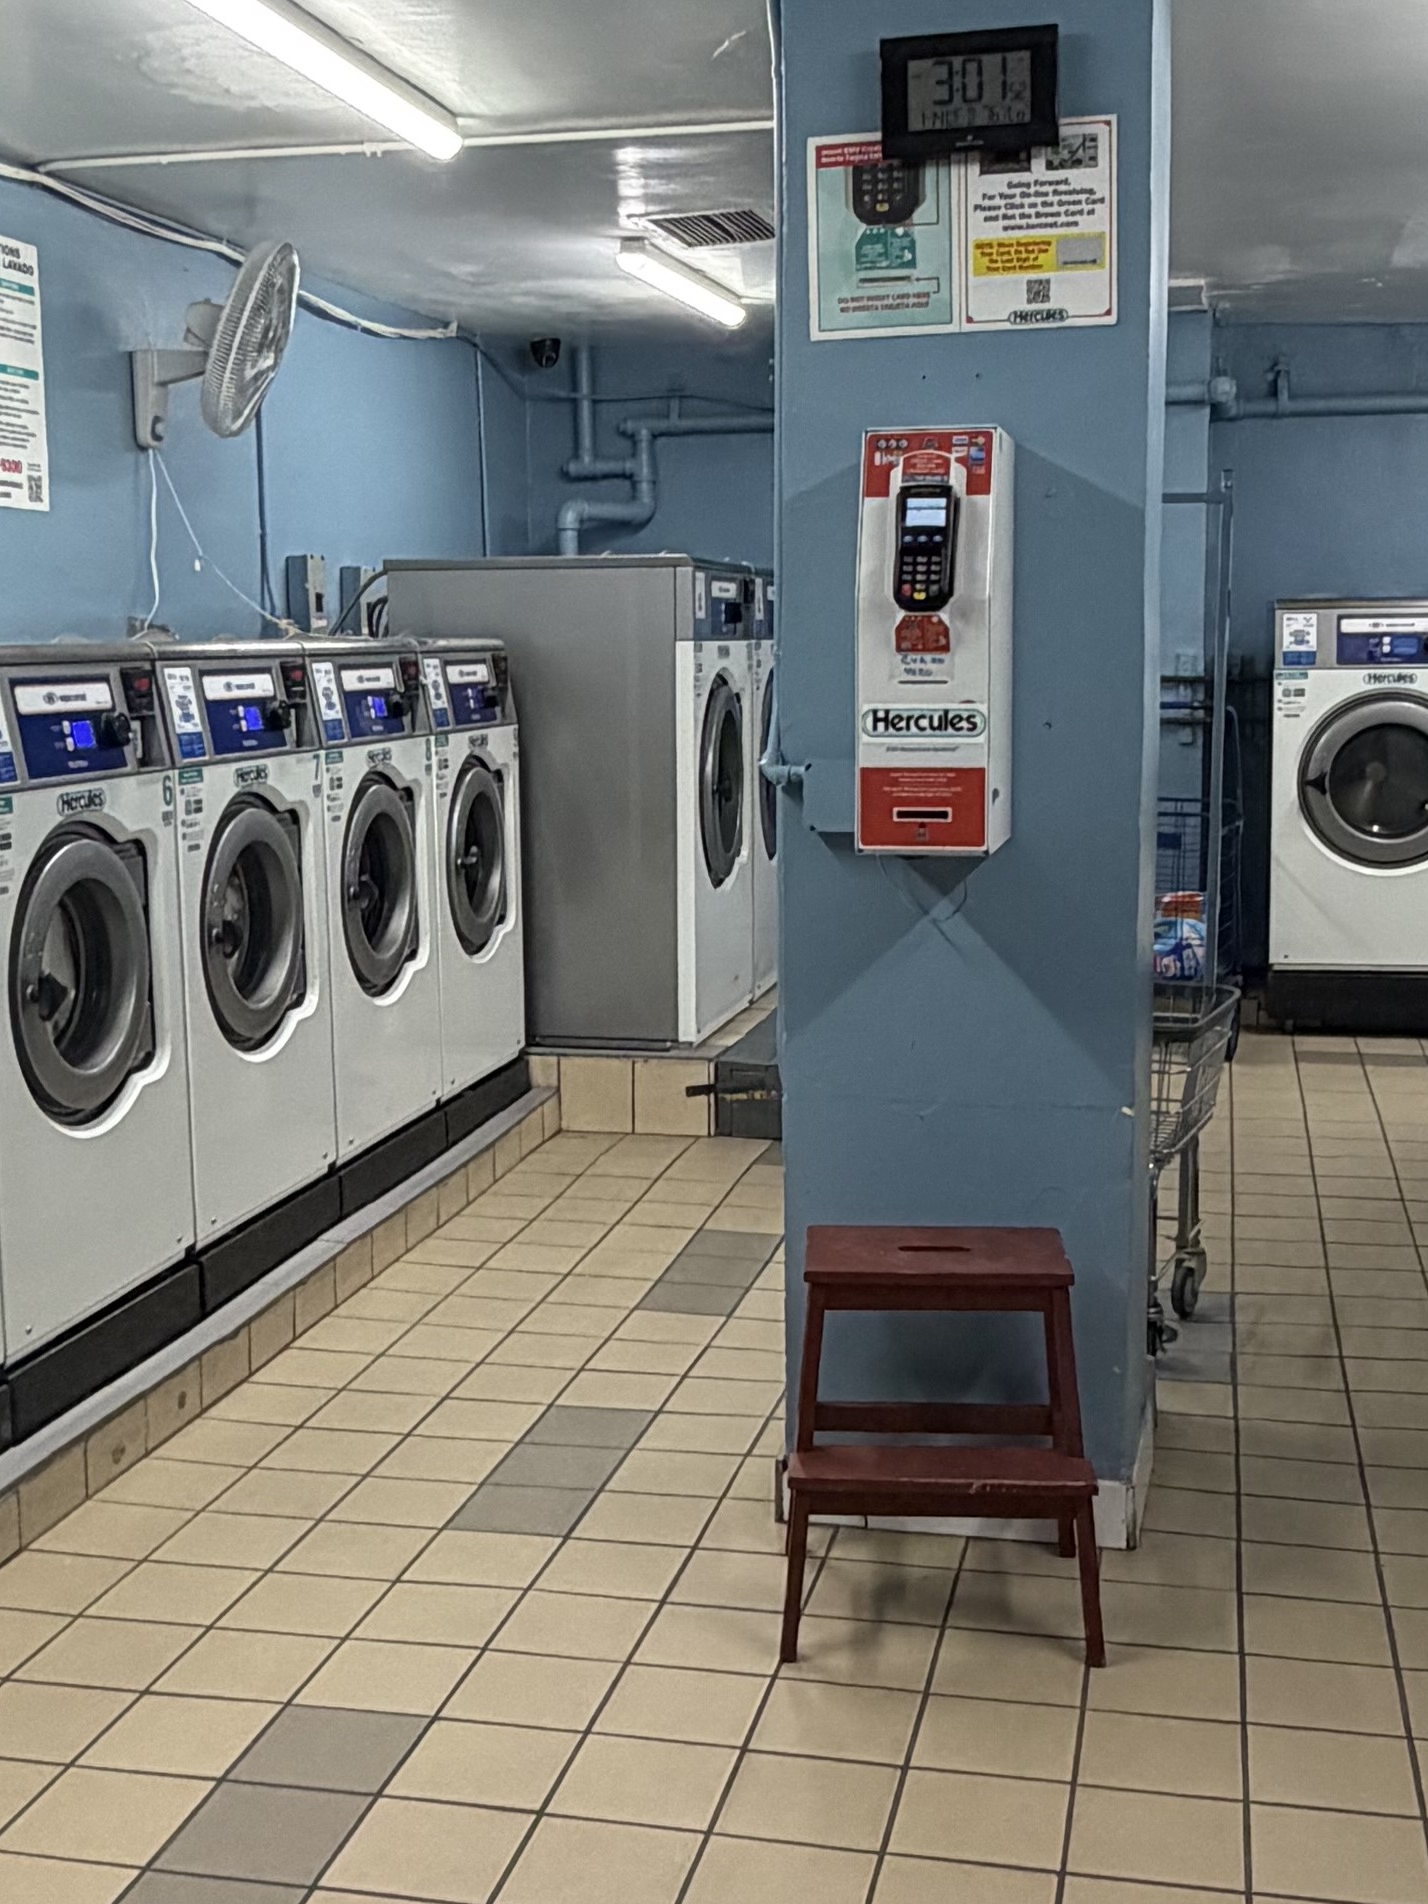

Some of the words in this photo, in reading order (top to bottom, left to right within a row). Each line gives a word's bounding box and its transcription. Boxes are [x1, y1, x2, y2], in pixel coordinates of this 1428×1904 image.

[932, 55, 1008, 106] 3:01
[1007, 179, 1032, 190] Going
[1013, 310, 1064, 324] Hercules
[1367, 672, 1415, 684] Hercules
[872, 709, 978, 732] Hercules
[313, 754, 320, 781] 7
[61, 789, 104, 814] Hercules
[163, 775, 173, 806] 6
